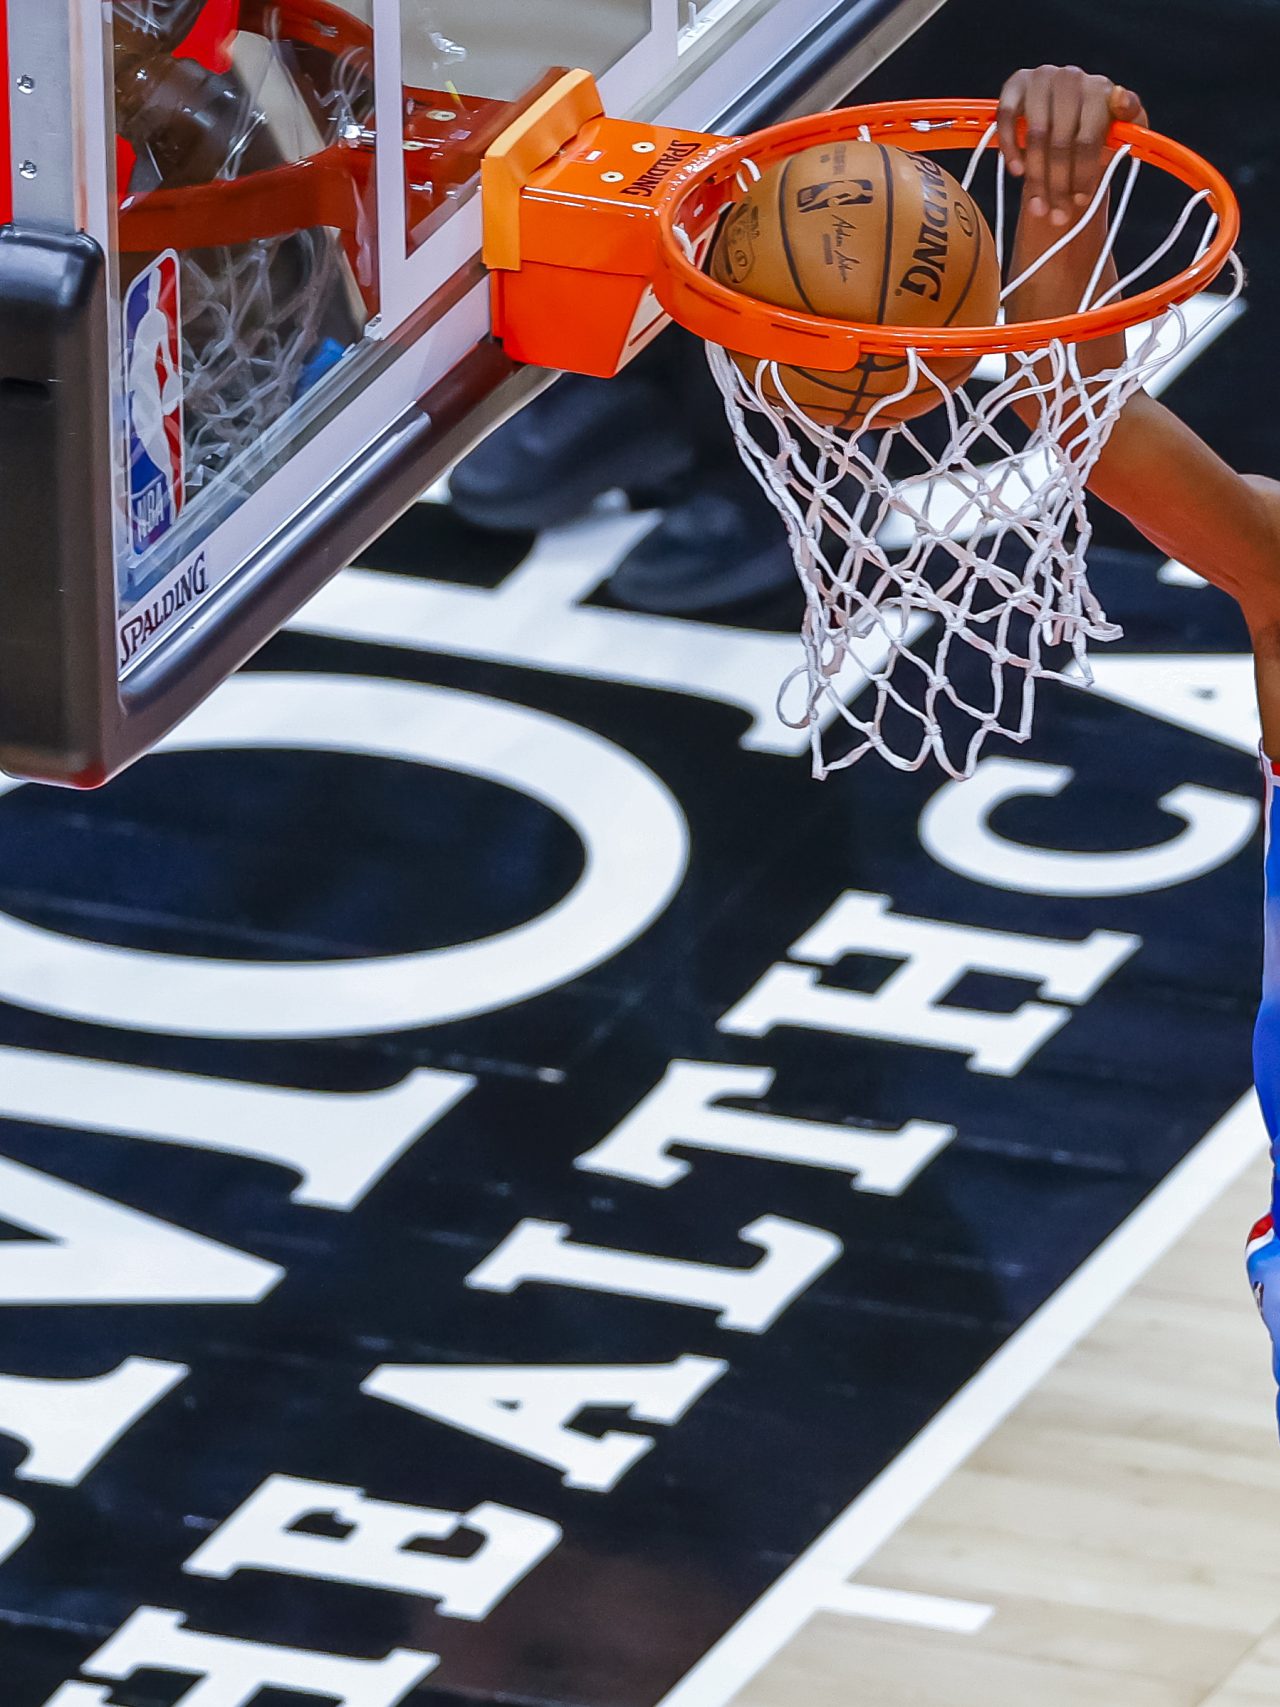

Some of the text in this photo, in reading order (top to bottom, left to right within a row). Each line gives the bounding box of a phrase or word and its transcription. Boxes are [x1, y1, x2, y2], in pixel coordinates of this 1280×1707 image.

[620, 139, 702, 197] SPALDING
[895, 147, 949, 303] SPALDING
[136, 482, 165, 543] NBA
[120, 551, 209, 668] SPALDING
